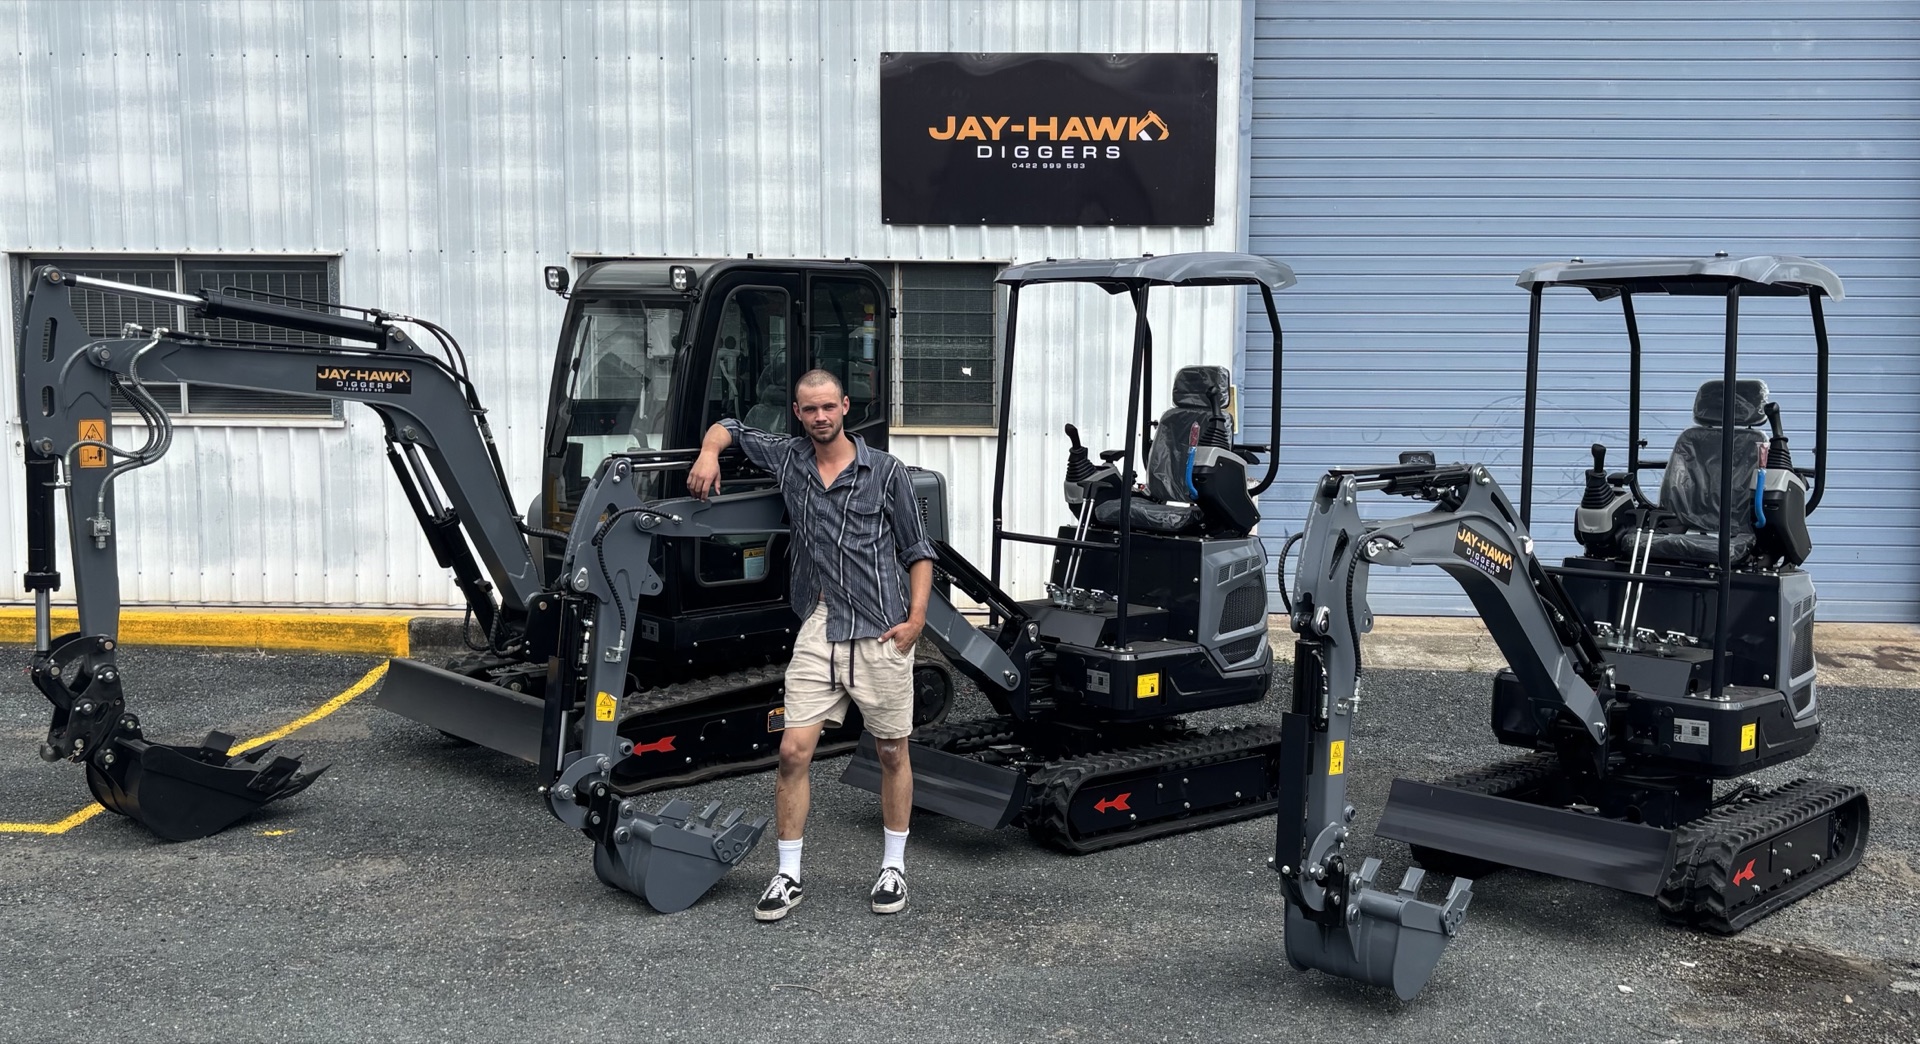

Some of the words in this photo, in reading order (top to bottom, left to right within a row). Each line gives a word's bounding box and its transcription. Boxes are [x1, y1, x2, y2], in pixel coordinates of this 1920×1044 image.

[928, 112, 1168, 141] JAY-HAWK
[977, 145, 1121, 159] DIGGERS
[317, 368, 411, 383] JAY-HAWK
[336, 380, 393, 389] DIGGERS
[1457, 528, 1513, 570] JAY-HAWK
[1466, 547, 1501, 573] DIGGERS
